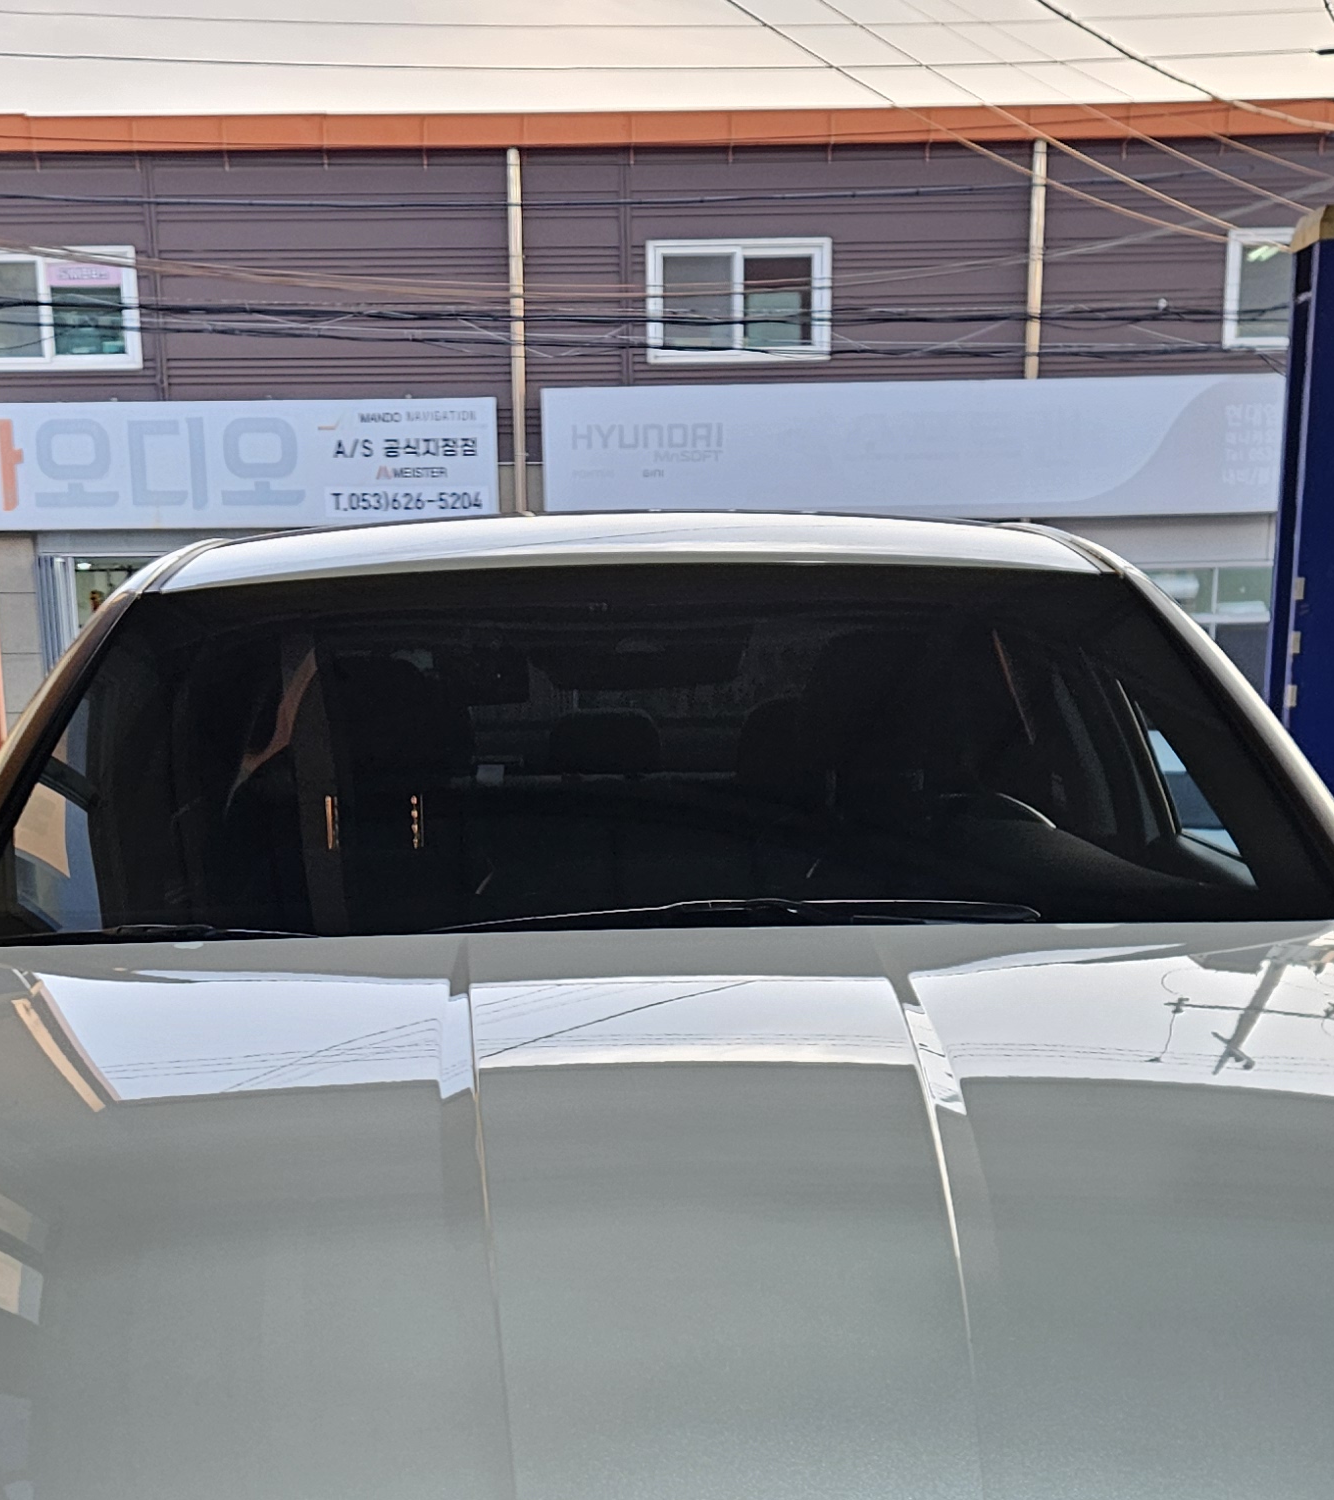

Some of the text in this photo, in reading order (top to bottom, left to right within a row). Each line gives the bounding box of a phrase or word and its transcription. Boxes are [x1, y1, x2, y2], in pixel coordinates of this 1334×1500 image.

[571, 423, 723, 450] HYUNDAI
[333, 439, 374, 458] A/S
[393, 467, 448, 478] MEISTER
